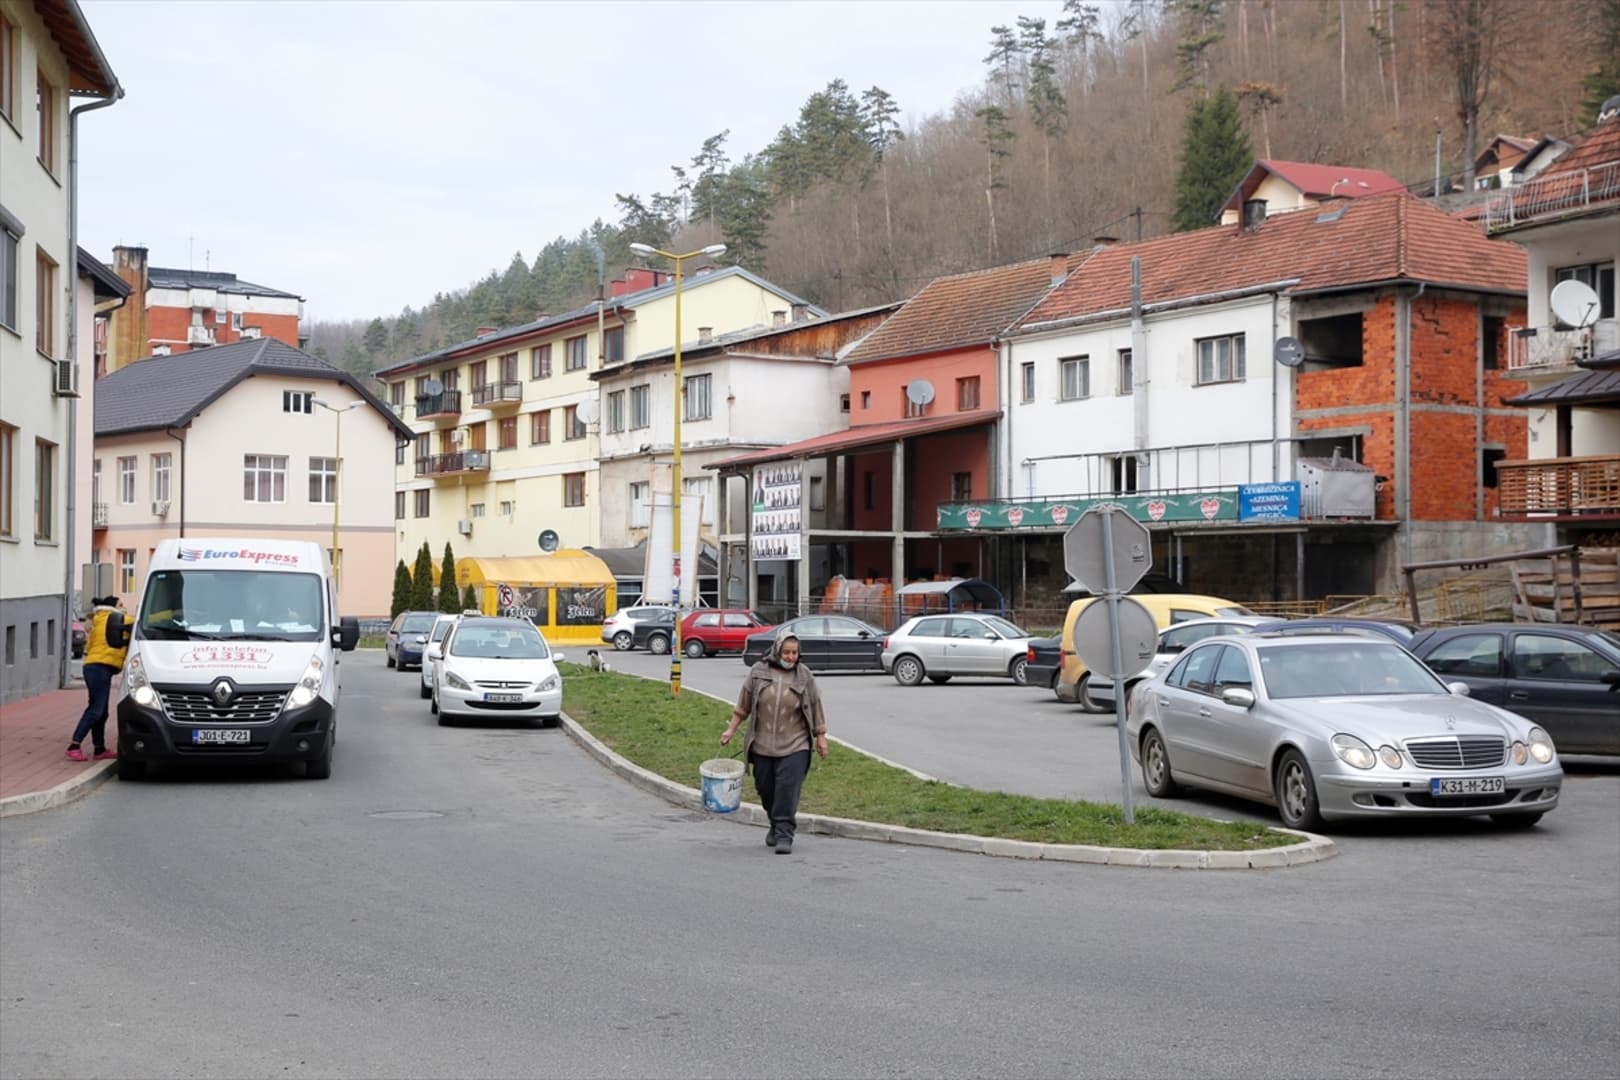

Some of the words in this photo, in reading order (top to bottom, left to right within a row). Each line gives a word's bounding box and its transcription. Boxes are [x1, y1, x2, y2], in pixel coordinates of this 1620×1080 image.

[203, 549, 299, 563] EuroExpress
[567, 605, 595, 619] Jelen
[222, 645, 268, 653] telefon
[208, 652, 257, 661] 1331
[199, 730, 249, 741] J01-E-721
[1440, 778, 1503, 793] K31-M-219
